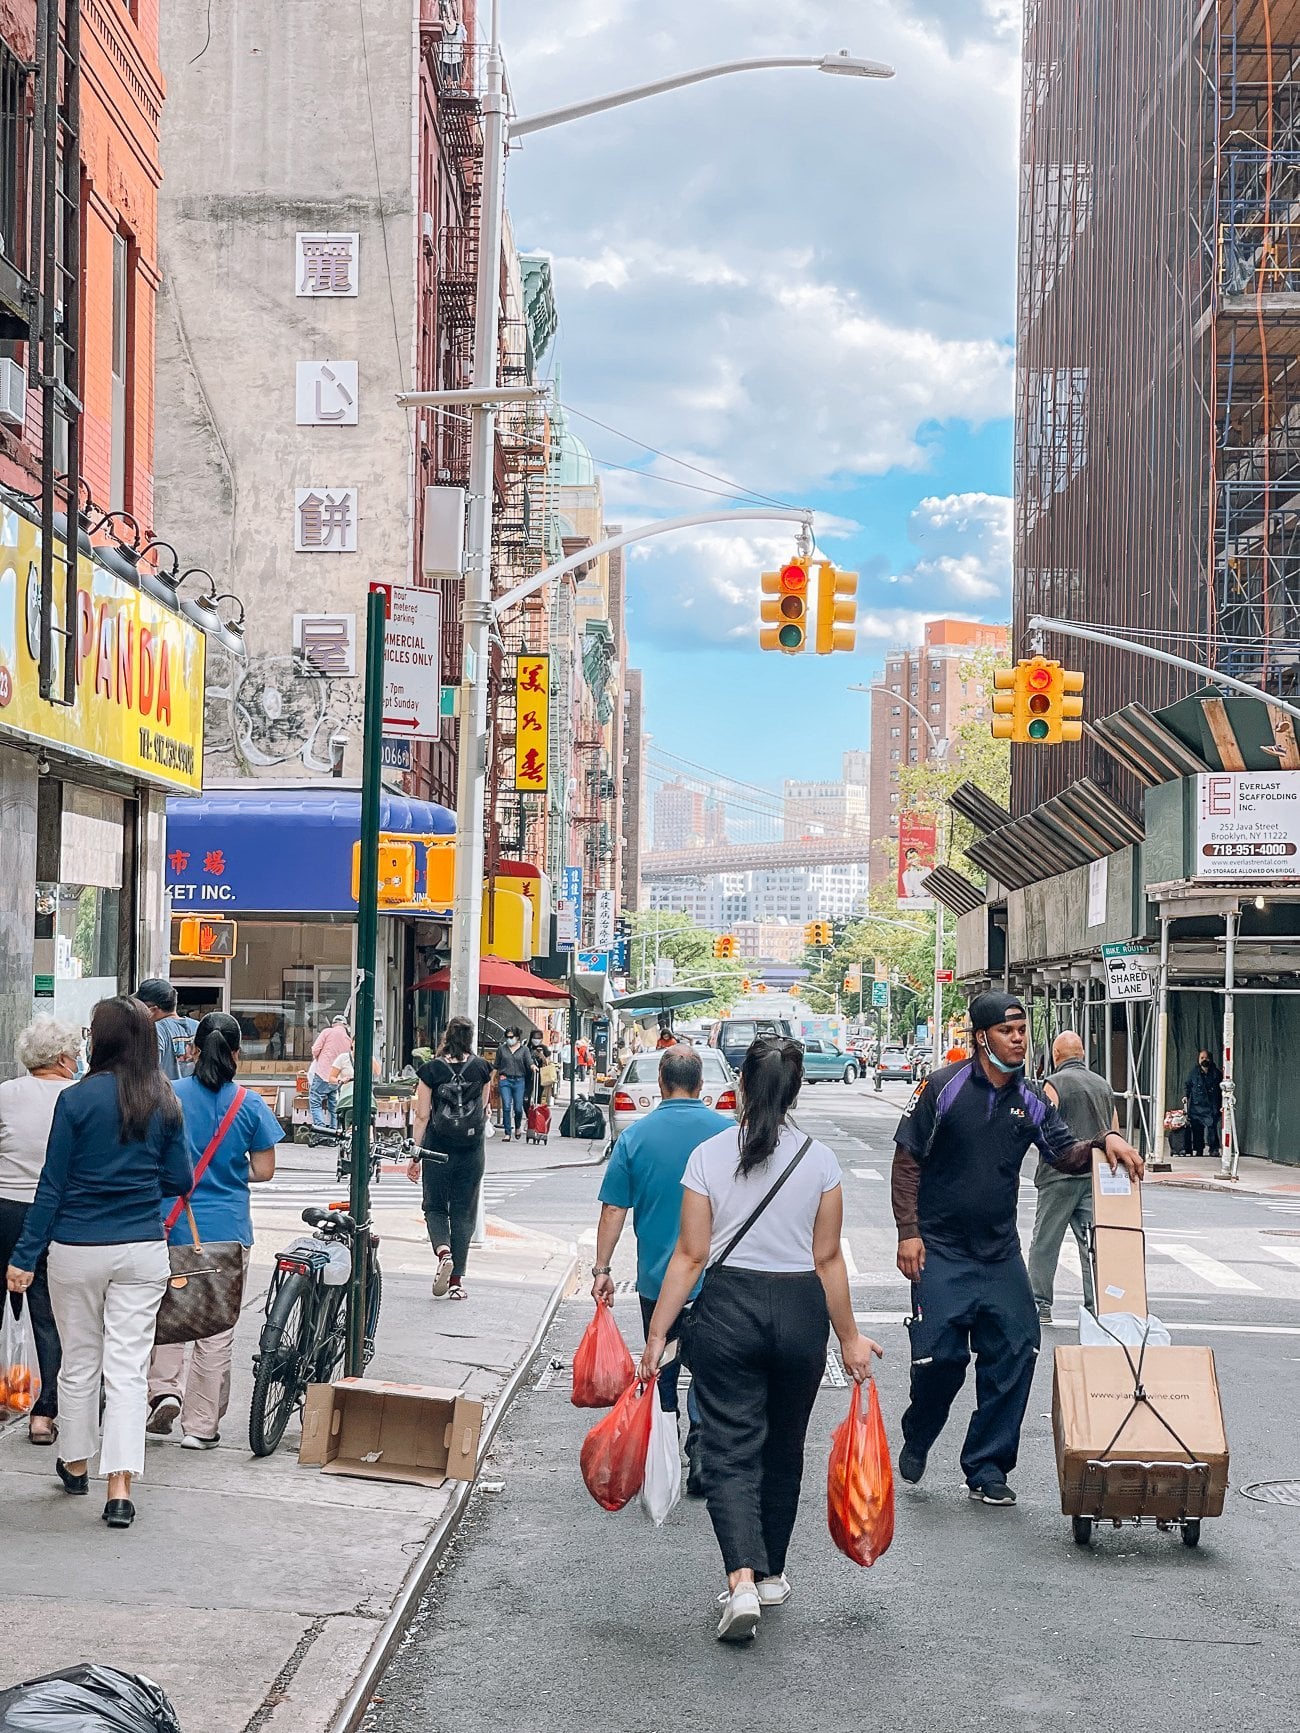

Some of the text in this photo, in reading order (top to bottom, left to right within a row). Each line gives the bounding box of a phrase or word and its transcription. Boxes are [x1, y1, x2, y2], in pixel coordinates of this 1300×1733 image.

[394, 590, 407, 600] hour
[394, 603, 418, 613] metered
[394, 613, 415, 625] parking
[76, 588, 171, 727] PANDA
[412, 652, 434, 667] ONLY
[390, 682, 404, 695] 7pm
[394, 697, 419, 712] Sunday
[1239, 782, 1281, 790] EVERLAST
[1209, 777, 1231, 815] E
[1239, 793, 1297, 801] SCAFFOLDING
[1239, 803, 1256, 811] INC.
[1219, 823, 1279, 831] 252 Java Street
[1211, 832, 1248, 841] Brooklyn,
[1264, 831, 1288, 839] 11222
[1212, 843, 1286, 856] 718-951-4000
[165, 884, 236, 900] KET INC.
[1105, 946, 1120, 955] BIKE
[1110, 972, 1148, 983] SHARED
[1118, 984, 1142, 994] LANE
